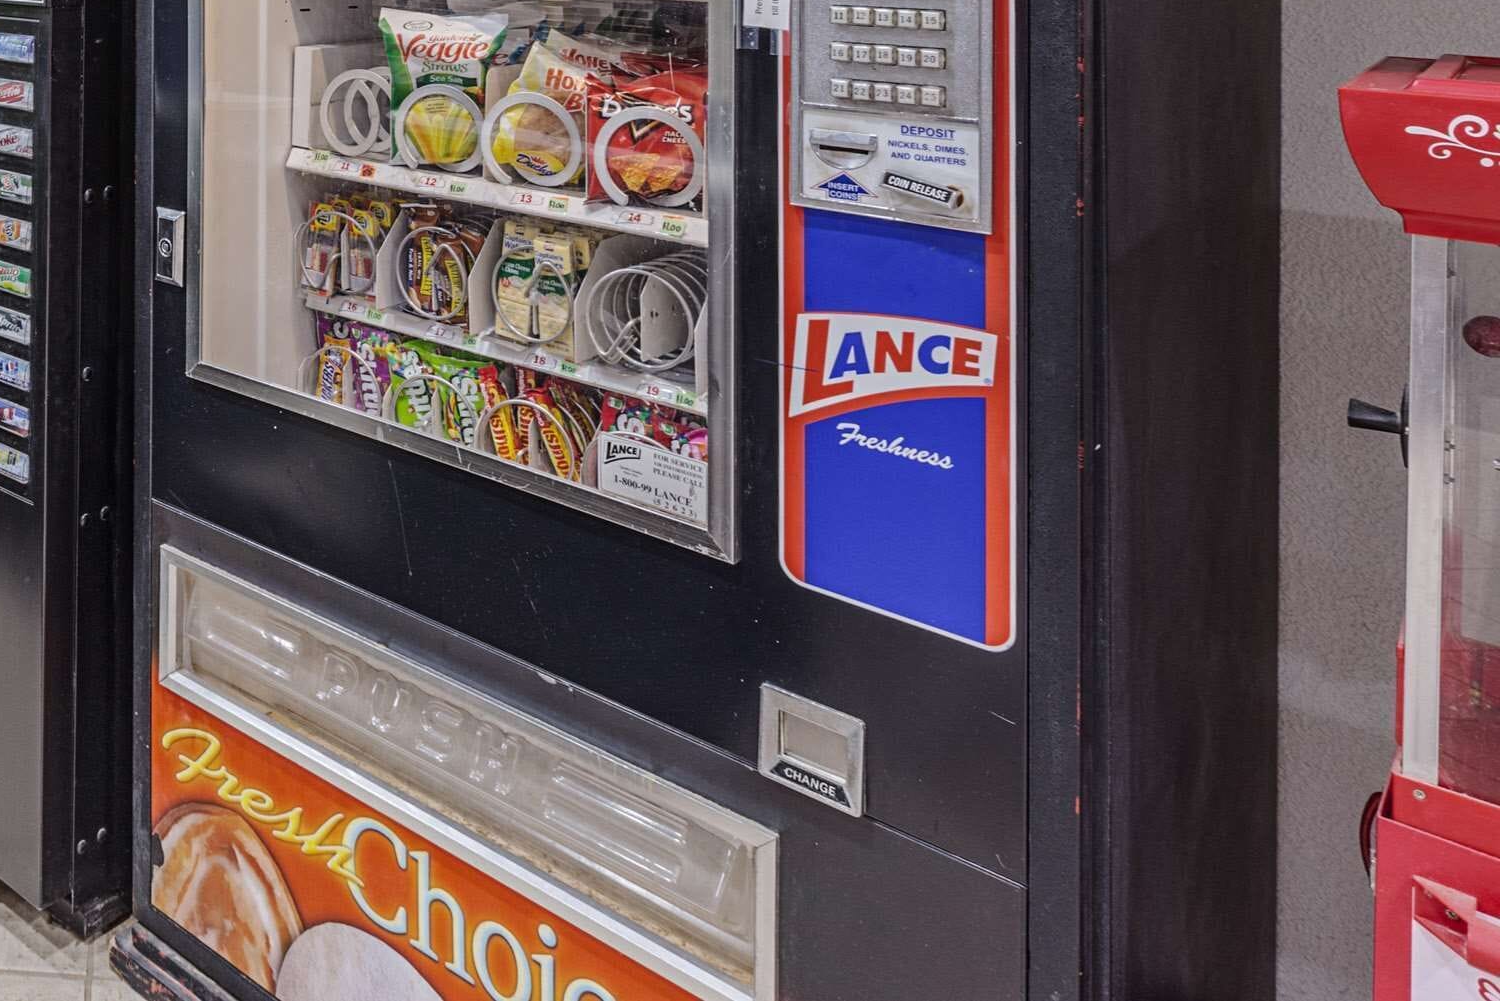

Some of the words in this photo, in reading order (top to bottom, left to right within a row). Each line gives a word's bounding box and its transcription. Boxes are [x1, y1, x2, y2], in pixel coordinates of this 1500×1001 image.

[834, 12, 844, 20] 11
[856, 12, 866, 20] 12
[879, 13, 889, 21] 13
[901, 15, 912, 24] 14
[925, 15, 937, 25] 15
[396, 32, 490, 63] Veggie
[833, 48, 844, 58] 16
[856, 50, 867, 59] 17
[878, 50, 889, 59] 18
[901, 53, 912, 62] 19
[924, 54, 936, 64] 20
[421, 61, 469, 73] Straws
[833, 84, 845, 93] 21
[854, 87, 866, 96] 22
[876, 88, 889, 97] 23
[900, 90, 912, 99] 24
[900, 125, 956, 139] DEPOSIT
[891, 152, 911, 160] AND
[914, 154, 966, 167] QUARTERS
[425, 177, 437, 185] 12
[827, 182, 860, 193] INSERT
[887, 175, 909, 189] COIN
[909, 181, 949, 202] RELEASE
[520, 194, 532, 203] 13
[829, 190, 858, 200] COINS
[628, 213, 641, 222] 14
[534, 356, 546, 365] 18
[802, 319, 982, 406] LANCE
[646, 386, 660, 395] 19
[606, 442, 637, 460] LANCE
[836, 423, 954, 470] Freshness
[654, 488, 693, 507] LANCE
[316, 653, 526, 796] PUSH
[784, 767, 836, 797] CHANGE
[160, 728, 365, 889] Fresh
[340, 816, 615, 1001] Choi
